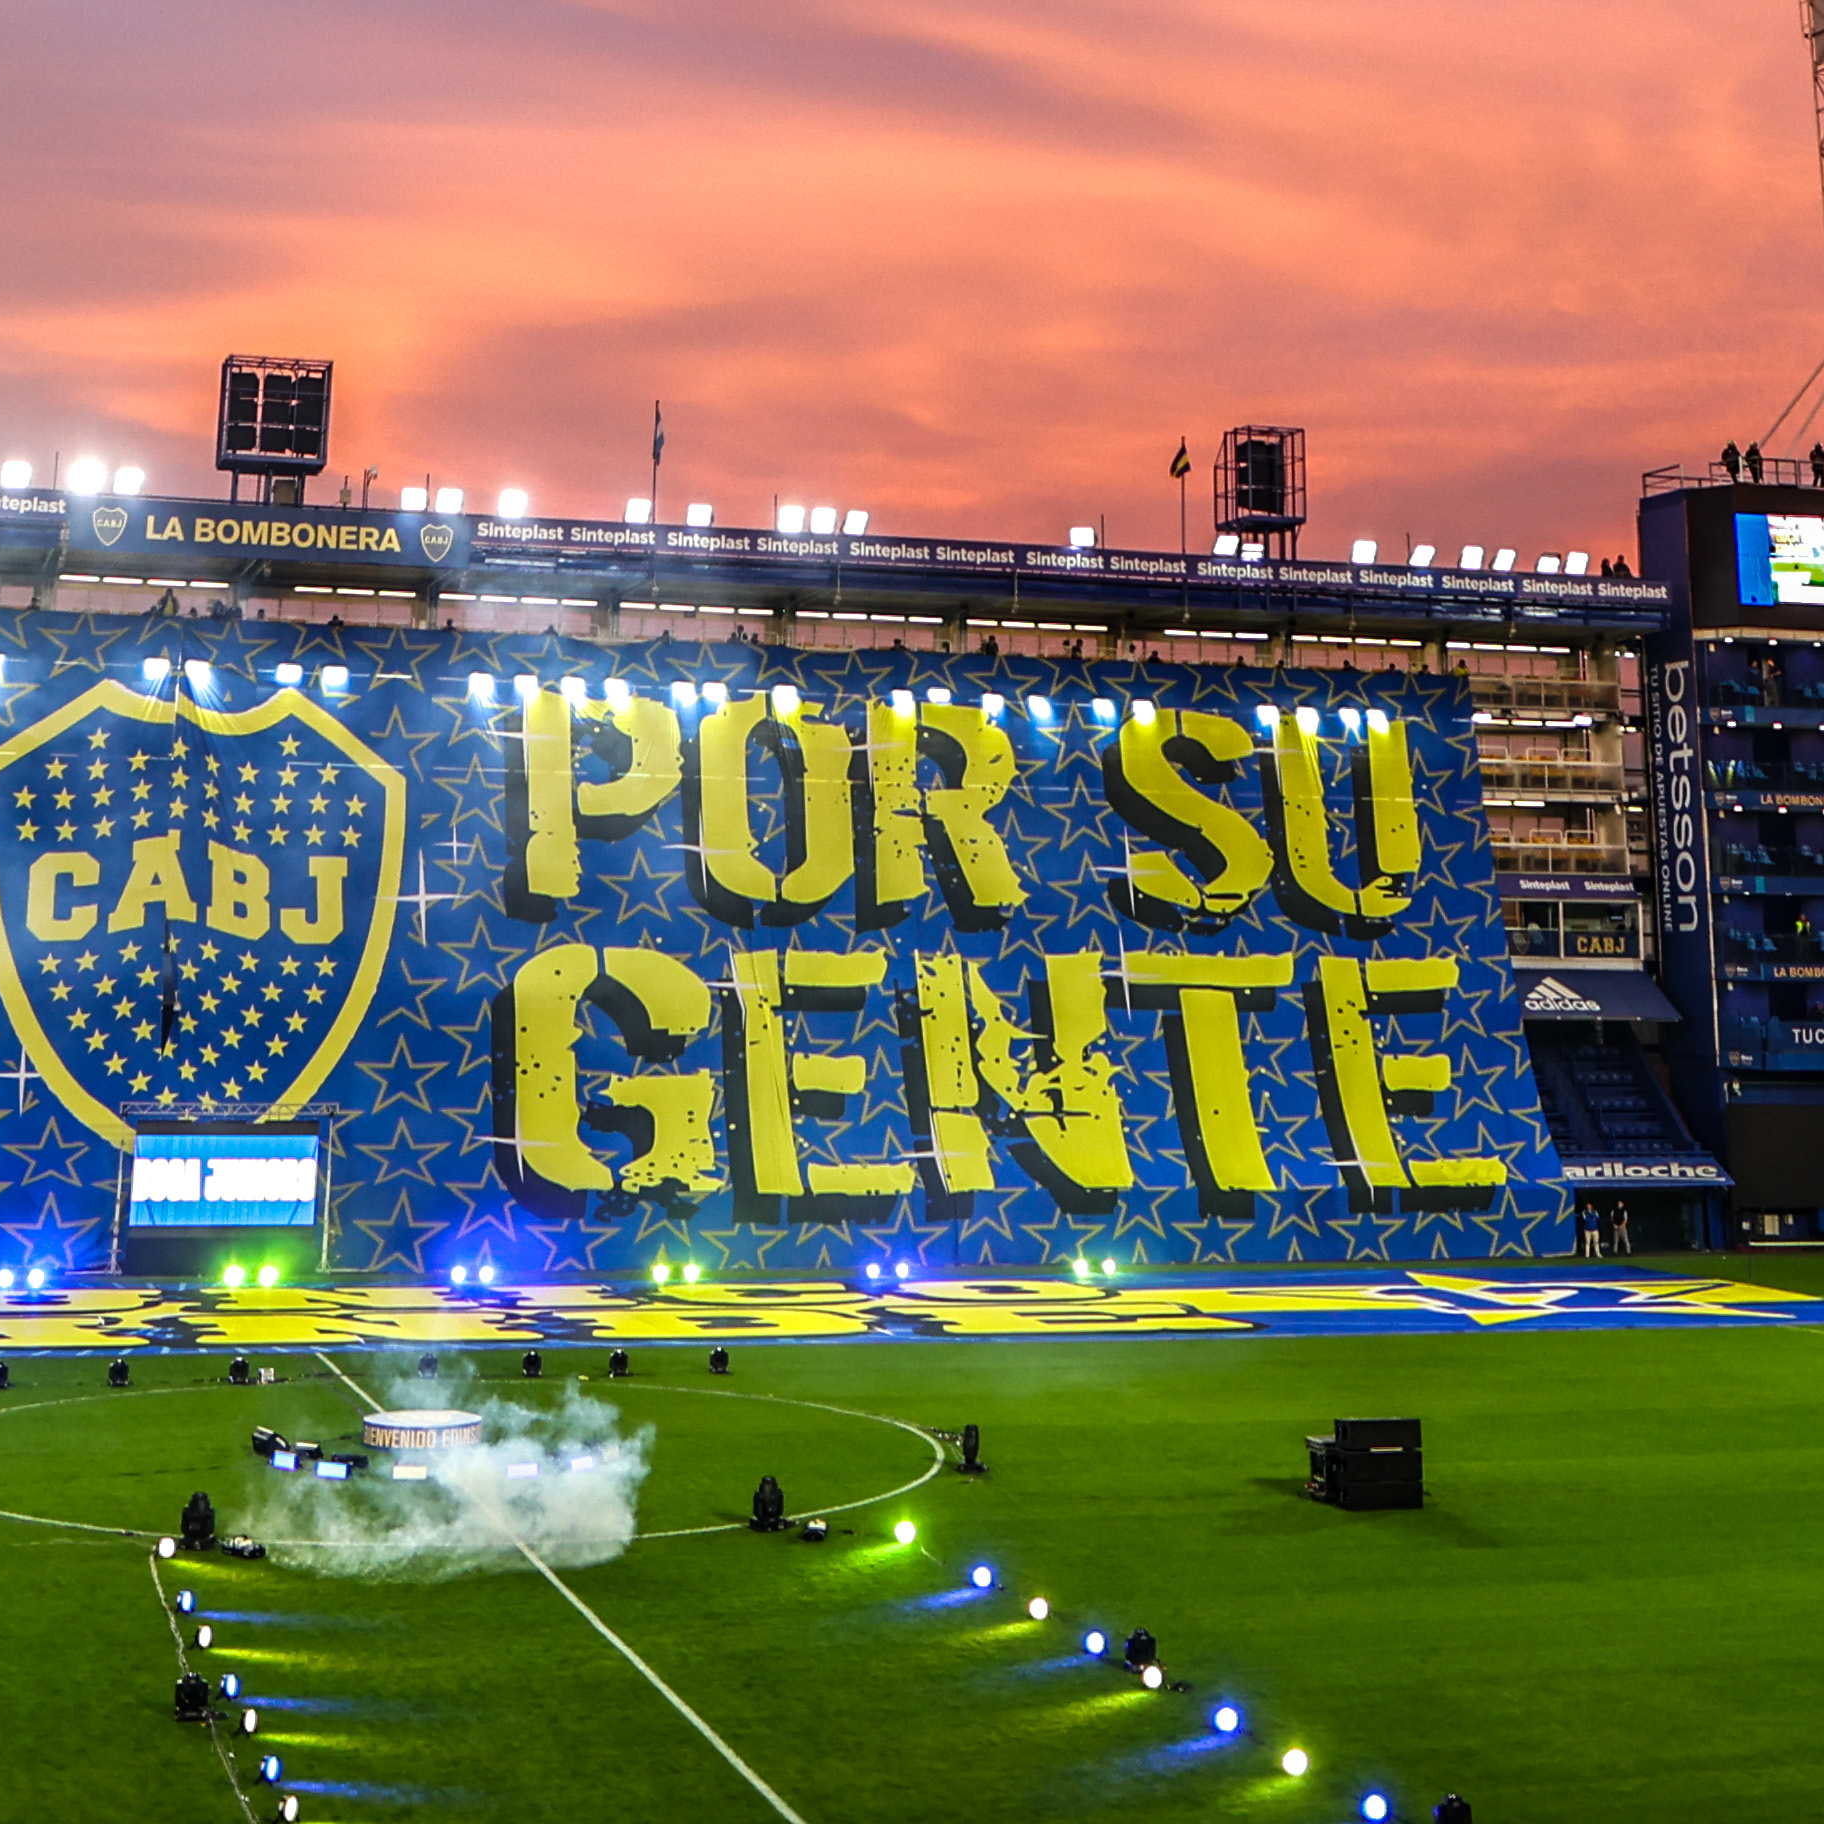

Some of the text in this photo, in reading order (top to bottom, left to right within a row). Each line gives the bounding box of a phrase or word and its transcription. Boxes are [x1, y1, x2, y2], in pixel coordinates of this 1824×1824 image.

[146, 515, 401, 553] LA BOMBONERA
[477, 522, 1668, 601] Sinteplast Sinteplast Sinteplast Sinteplast Sinteplast Sinteplast Sinteplast Sinteplast Sinteplast Sinteplast Sinteplast Sinteplast Sinteplast Sinteplast
[525, 686, 1422, 920] POR SU
[1650, 664, 1673, 932] TU SITIO DE APUESTAS ONLINE
[1664, 660, 1699, 932] betsson
[1760, 794, 1773, 805] LA
[26, 829, 348, 945] CABJ
[1519, 879, 1635, 893] Sinteplast Sinteplast
[1577, 935, 1626, 955] CABJ
[1774, 967, 1787, 977] LA
[1524, 992, 1601, 1012] adidas
[513, 942, 1507, 1196] GENTE
